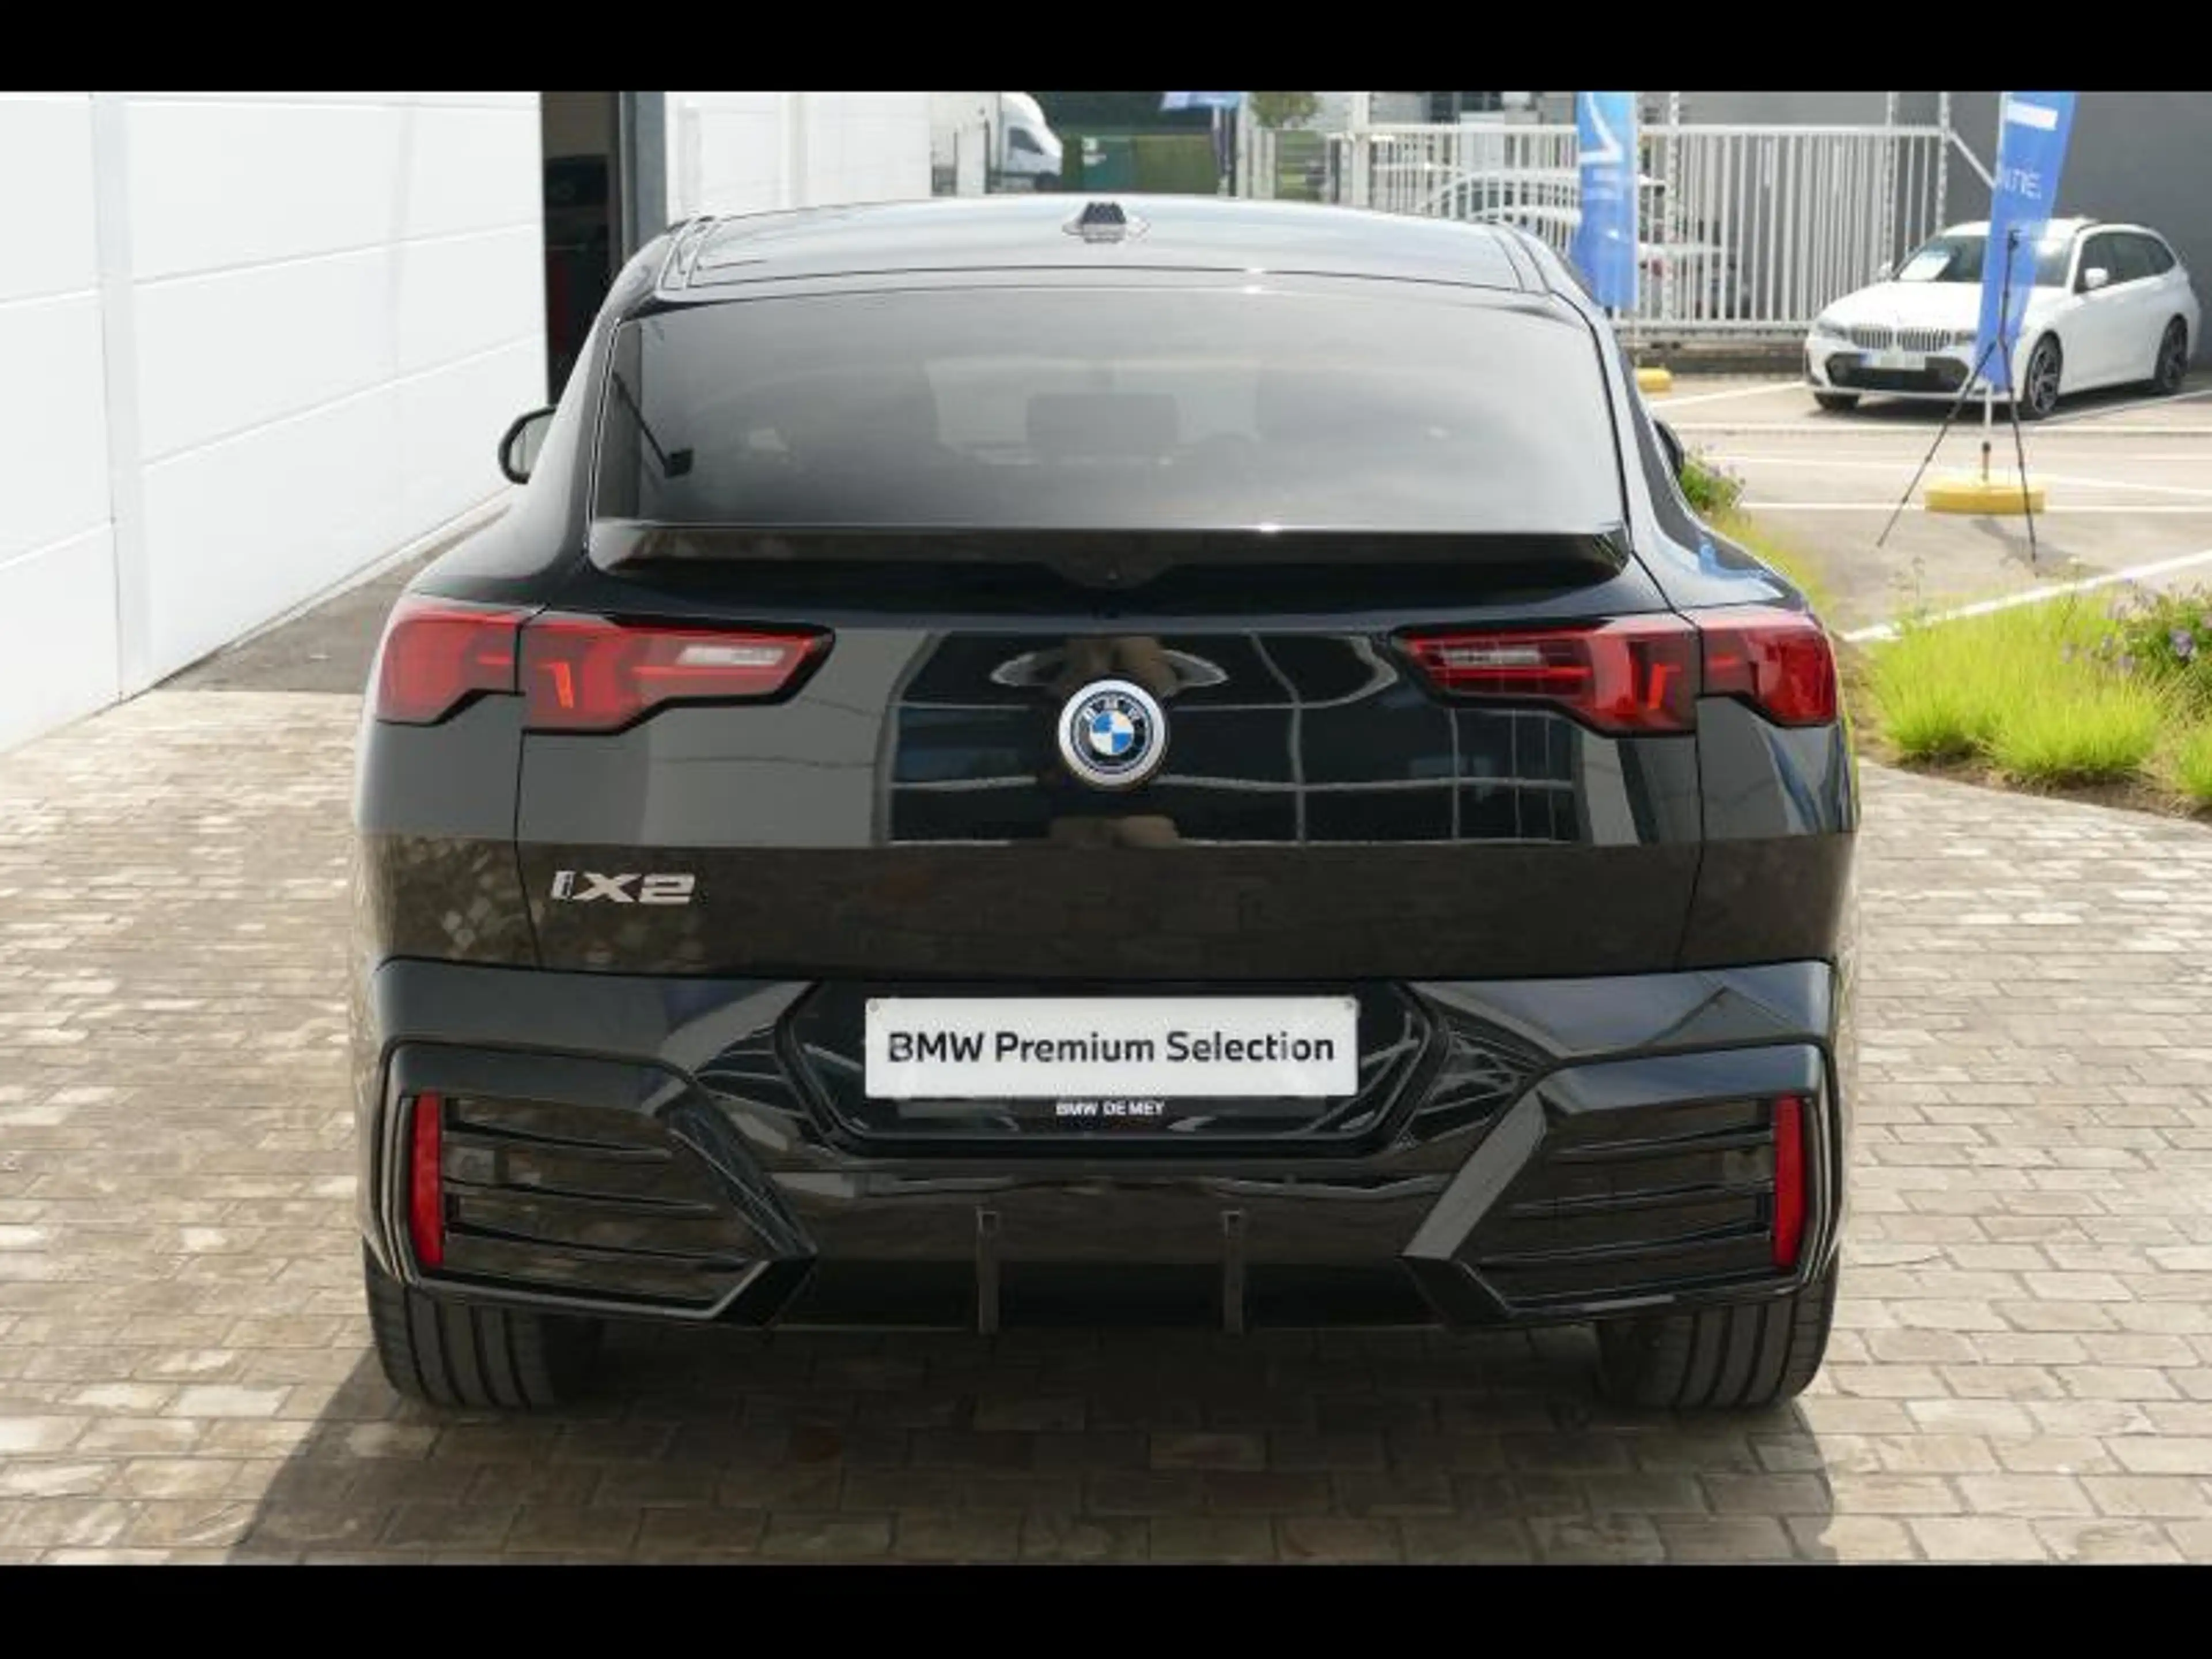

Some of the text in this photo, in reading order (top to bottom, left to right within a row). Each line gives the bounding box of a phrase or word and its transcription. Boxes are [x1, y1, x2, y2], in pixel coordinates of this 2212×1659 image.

[888, 1030, 1334, 1063] BMW Premium Selection
[1056, 1100, 1164, 1116] BMW DE MEY
